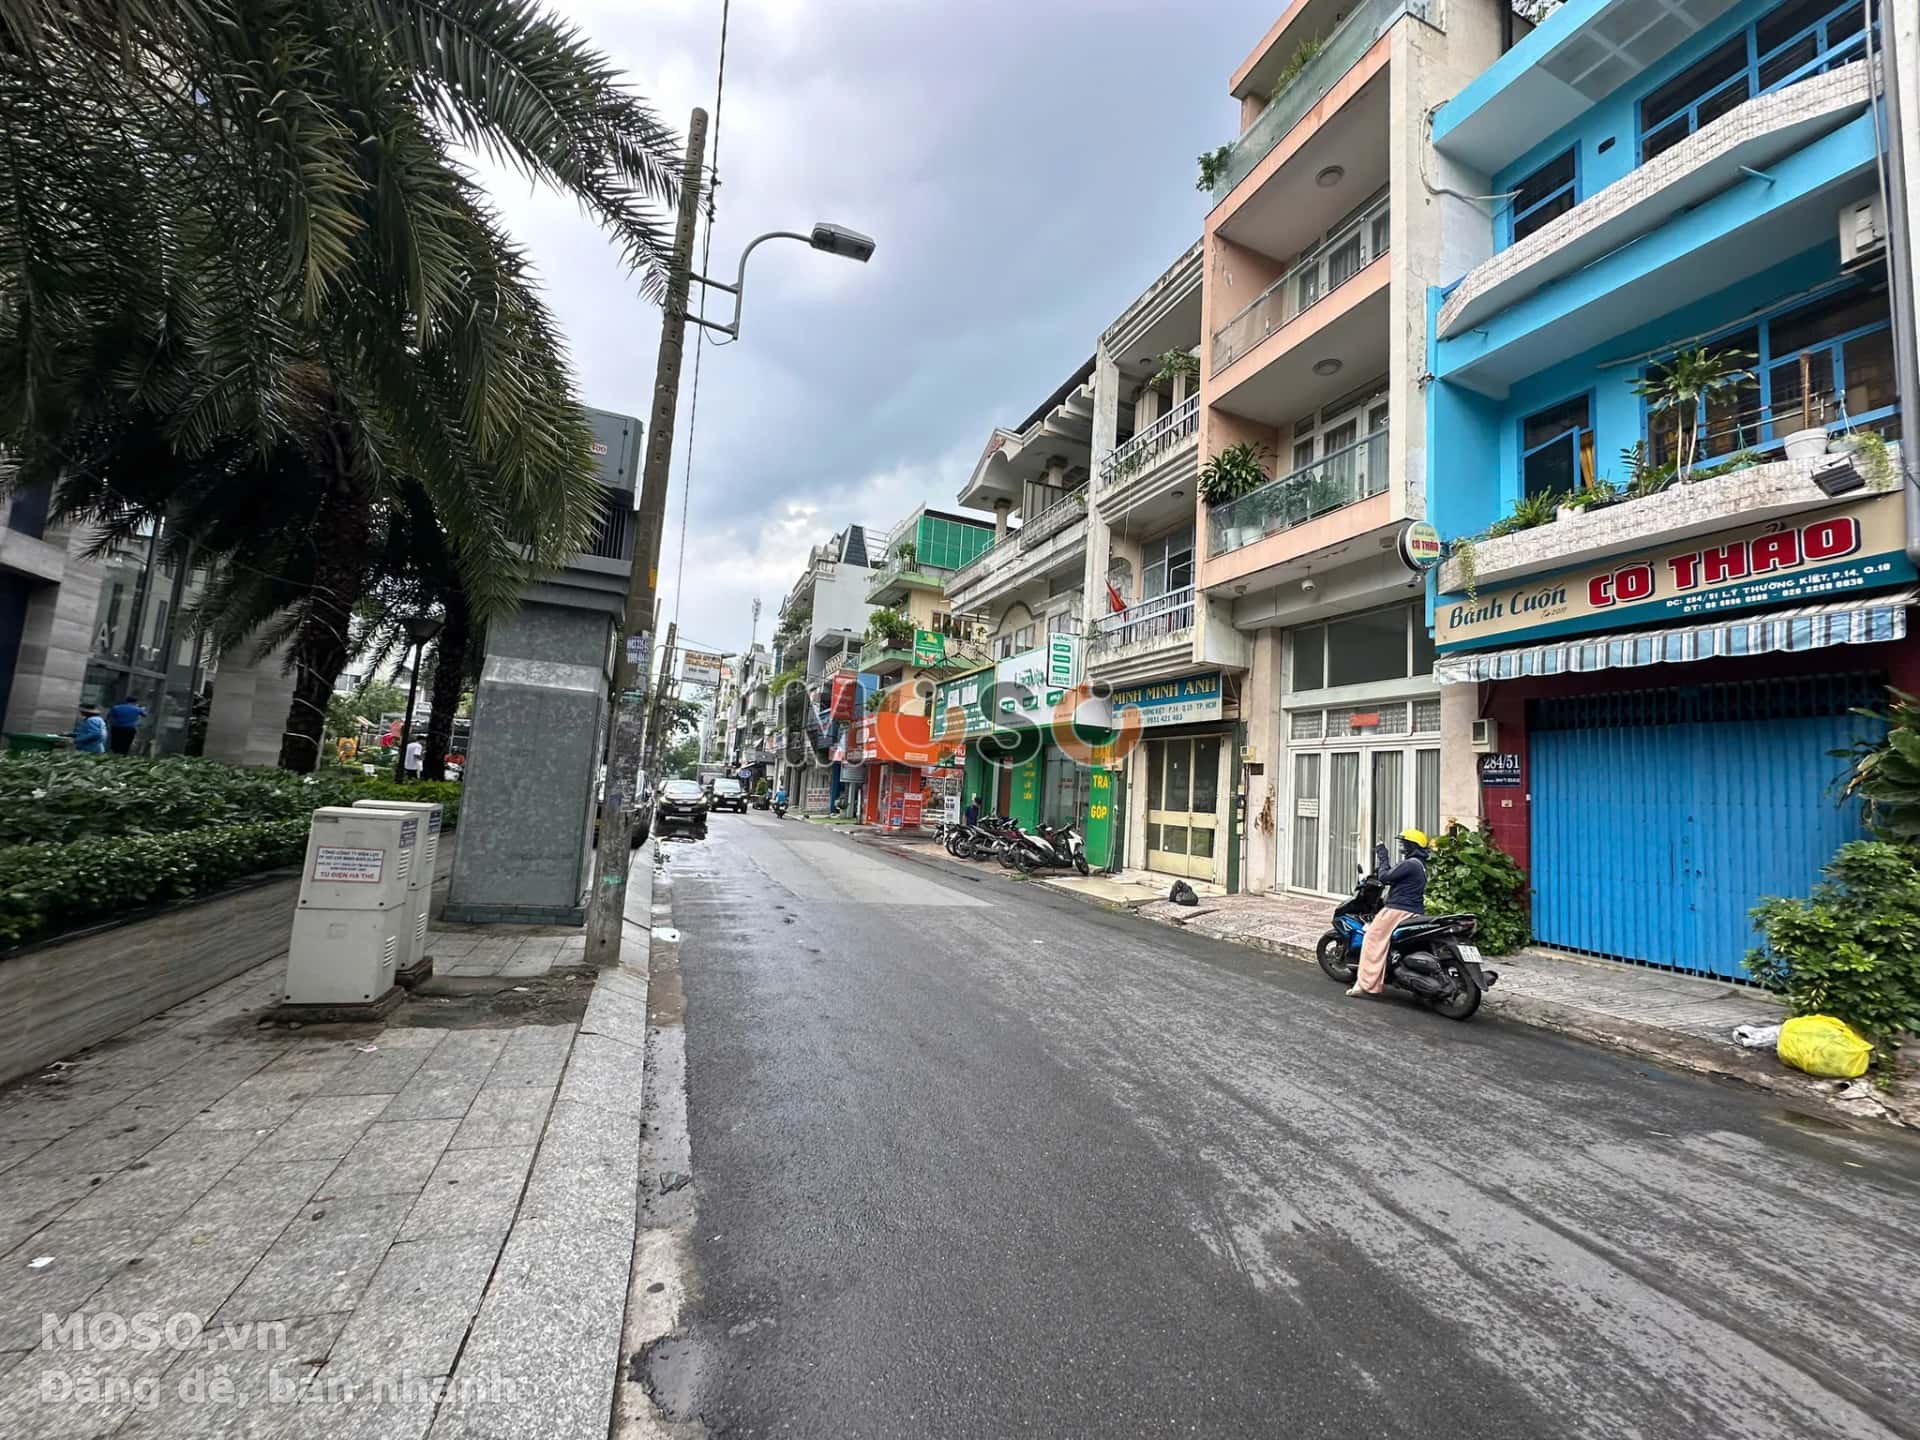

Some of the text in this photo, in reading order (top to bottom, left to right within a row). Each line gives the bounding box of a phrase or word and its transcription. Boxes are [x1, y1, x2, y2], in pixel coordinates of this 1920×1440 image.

[1587, 516, 1860, 608] CÔ THẢO
[1510, 584, 1567, 615] Cuốn
[1146, 683, 1179, 700] MINH
[1183, 677, 1217, 696] ANH
[1483, 753, 1520, 769] 284/51
